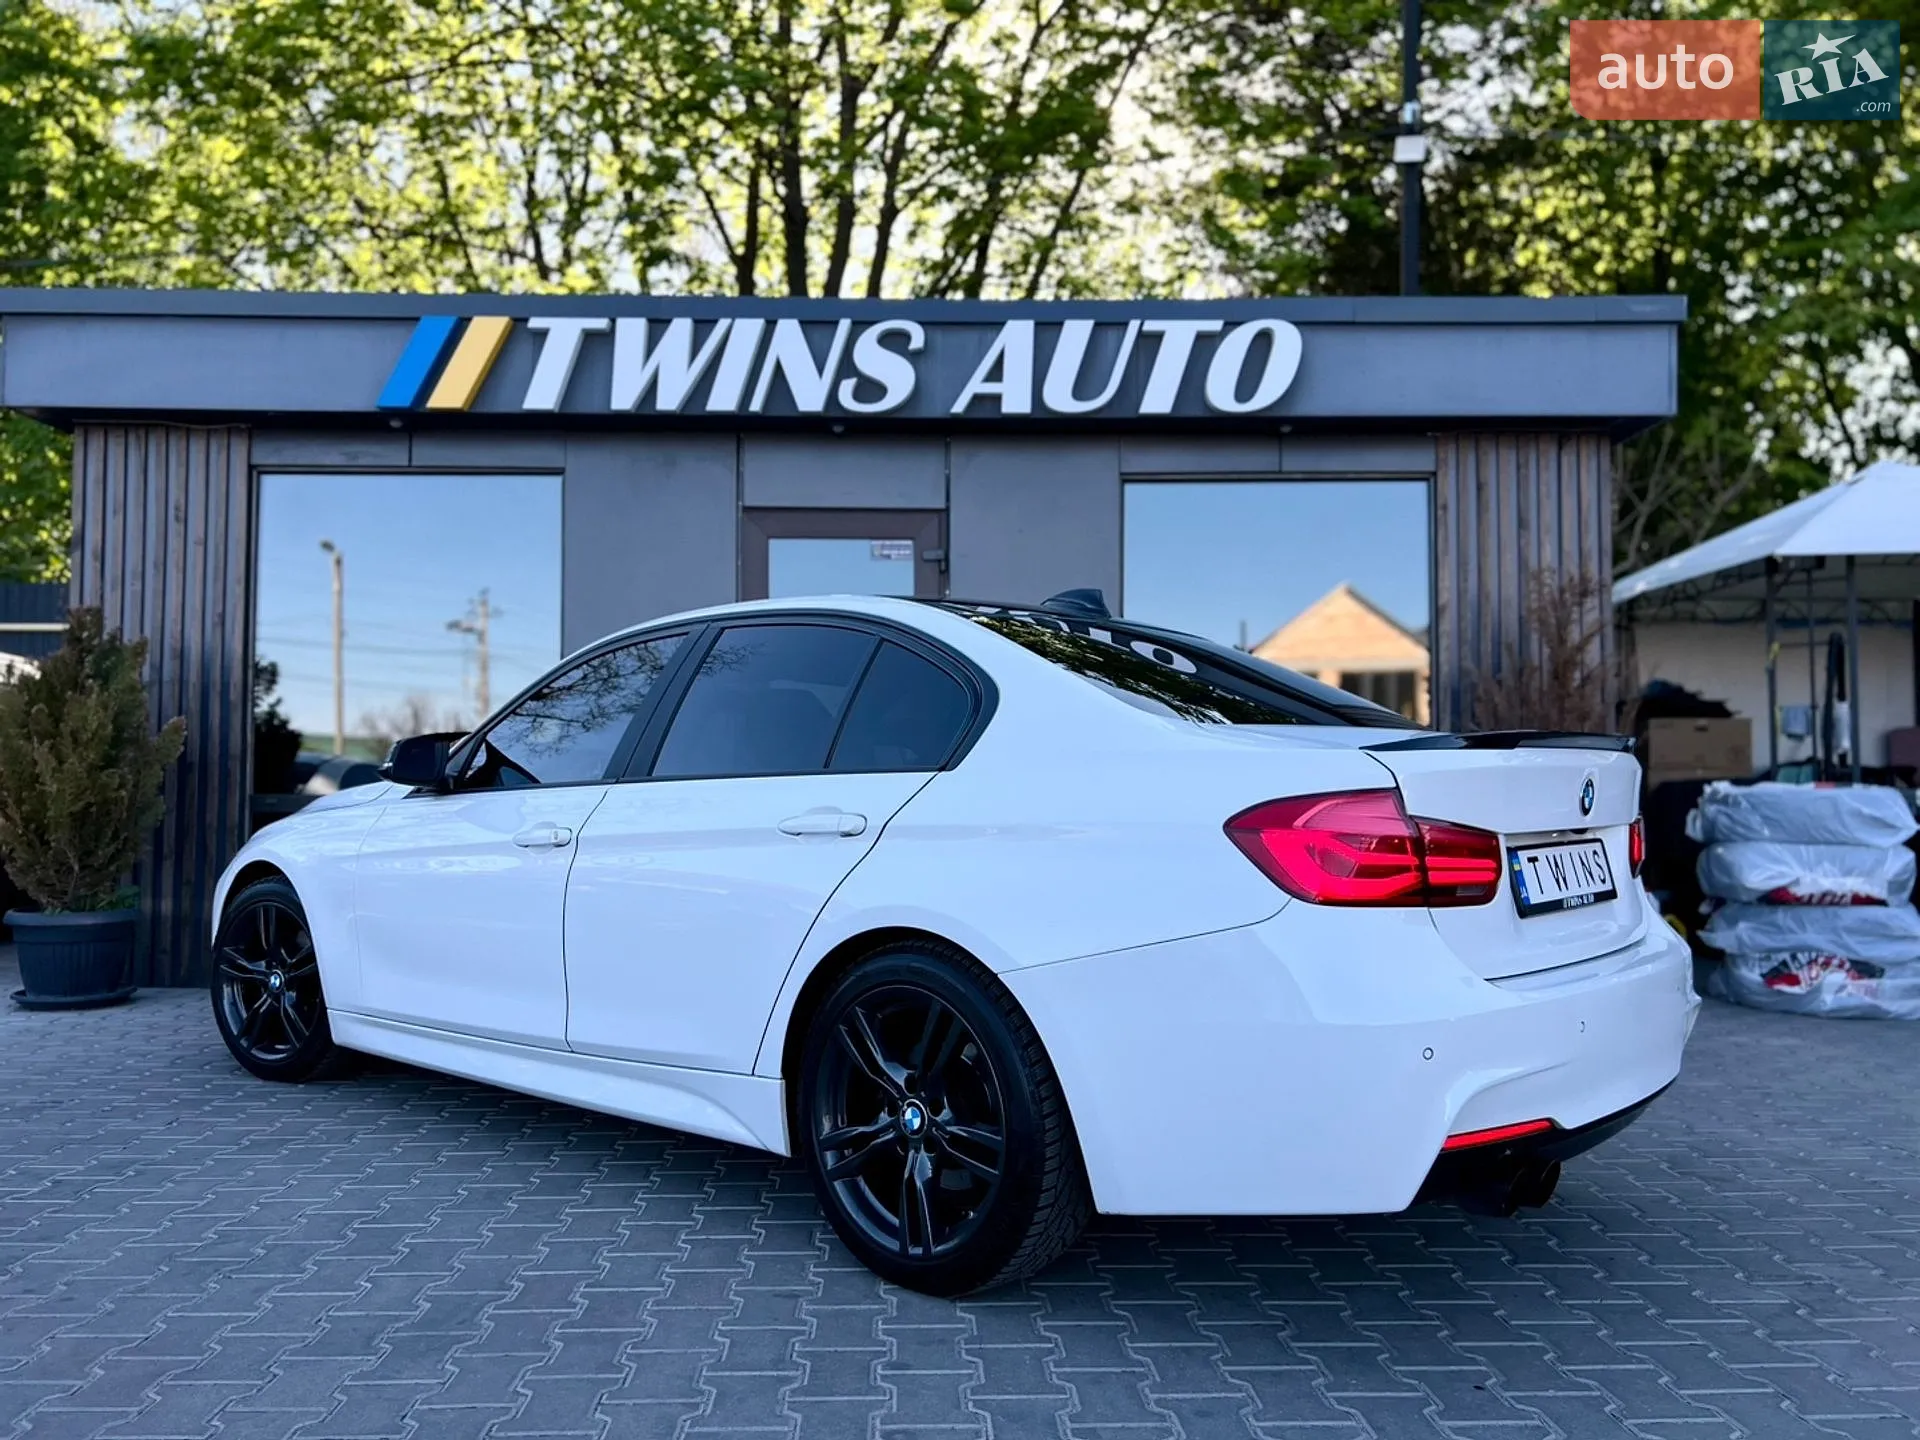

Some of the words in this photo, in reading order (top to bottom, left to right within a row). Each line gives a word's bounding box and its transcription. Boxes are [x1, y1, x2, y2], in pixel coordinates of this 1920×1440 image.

[521, 316, 926, 415] TWINS
[950, 317, 1304, 416] AUTO
[1527, 849, 1607, 895] TWINS
